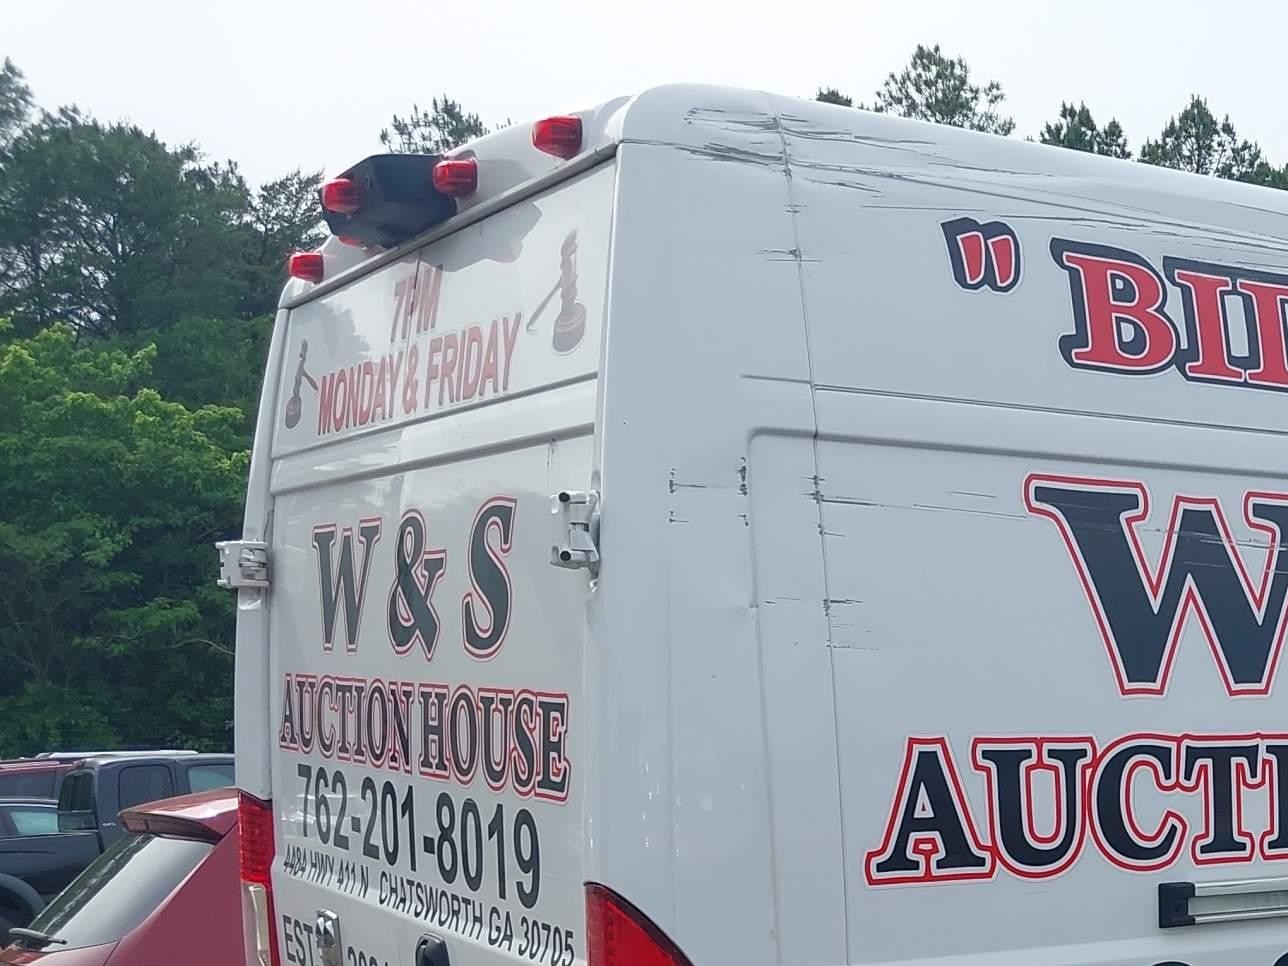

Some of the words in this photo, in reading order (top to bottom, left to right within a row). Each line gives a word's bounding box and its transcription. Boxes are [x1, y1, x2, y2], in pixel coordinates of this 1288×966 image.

[390, 264, 443, 343] 7PM
[318, 347, 403, 437] MONDAY
[402, 353, 419, 415] &
[424, 313, 521, 410] FRIDAY
[312, 516, 382, 654] W
[387, 508, 446, 662] &
[462, 496, 517, 662] S
[280, 673, 414, 775] AUCTION
[418, 683, 571, 802] HOUSE
[283, 843, 307, 878] 4484
[307, 850, 335, 887] HWY
[337, 858, 356, 894] 411
[358, 865, 369, 899] N
[379, 871, 483, 940] CHATSWORTH
[488, 906, 513, 952] GA
[298, 764, 540, 908] 762-201-8019
